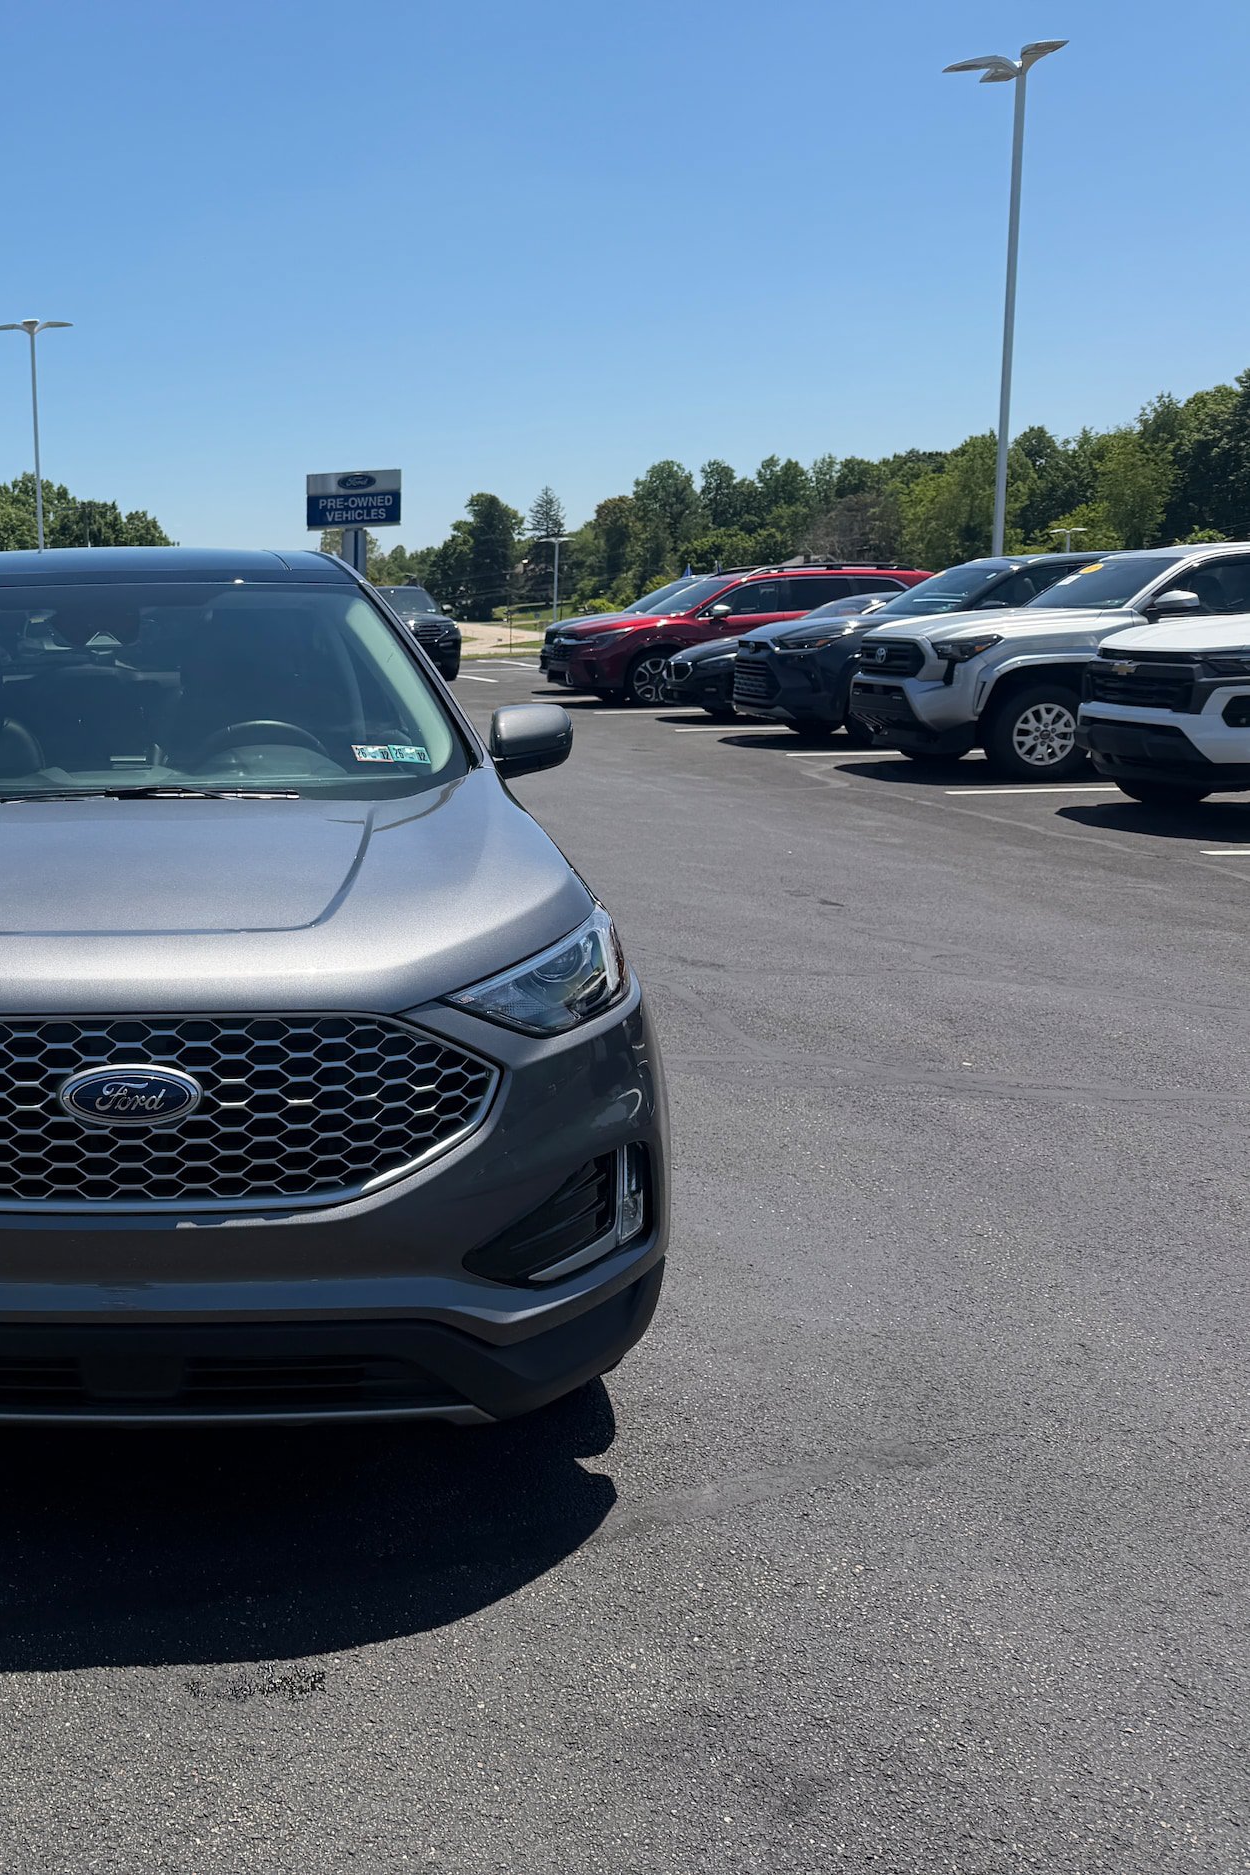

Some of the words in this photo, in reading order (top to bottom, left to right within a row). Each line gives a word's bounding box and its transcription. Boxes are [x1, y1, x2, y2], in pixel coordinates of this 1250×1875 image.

[319, 495, 393, 510] PRE-OWNED
[326, 508, 386, 522] VEHICLES
[95, 1082, 166, 1111] Ford
